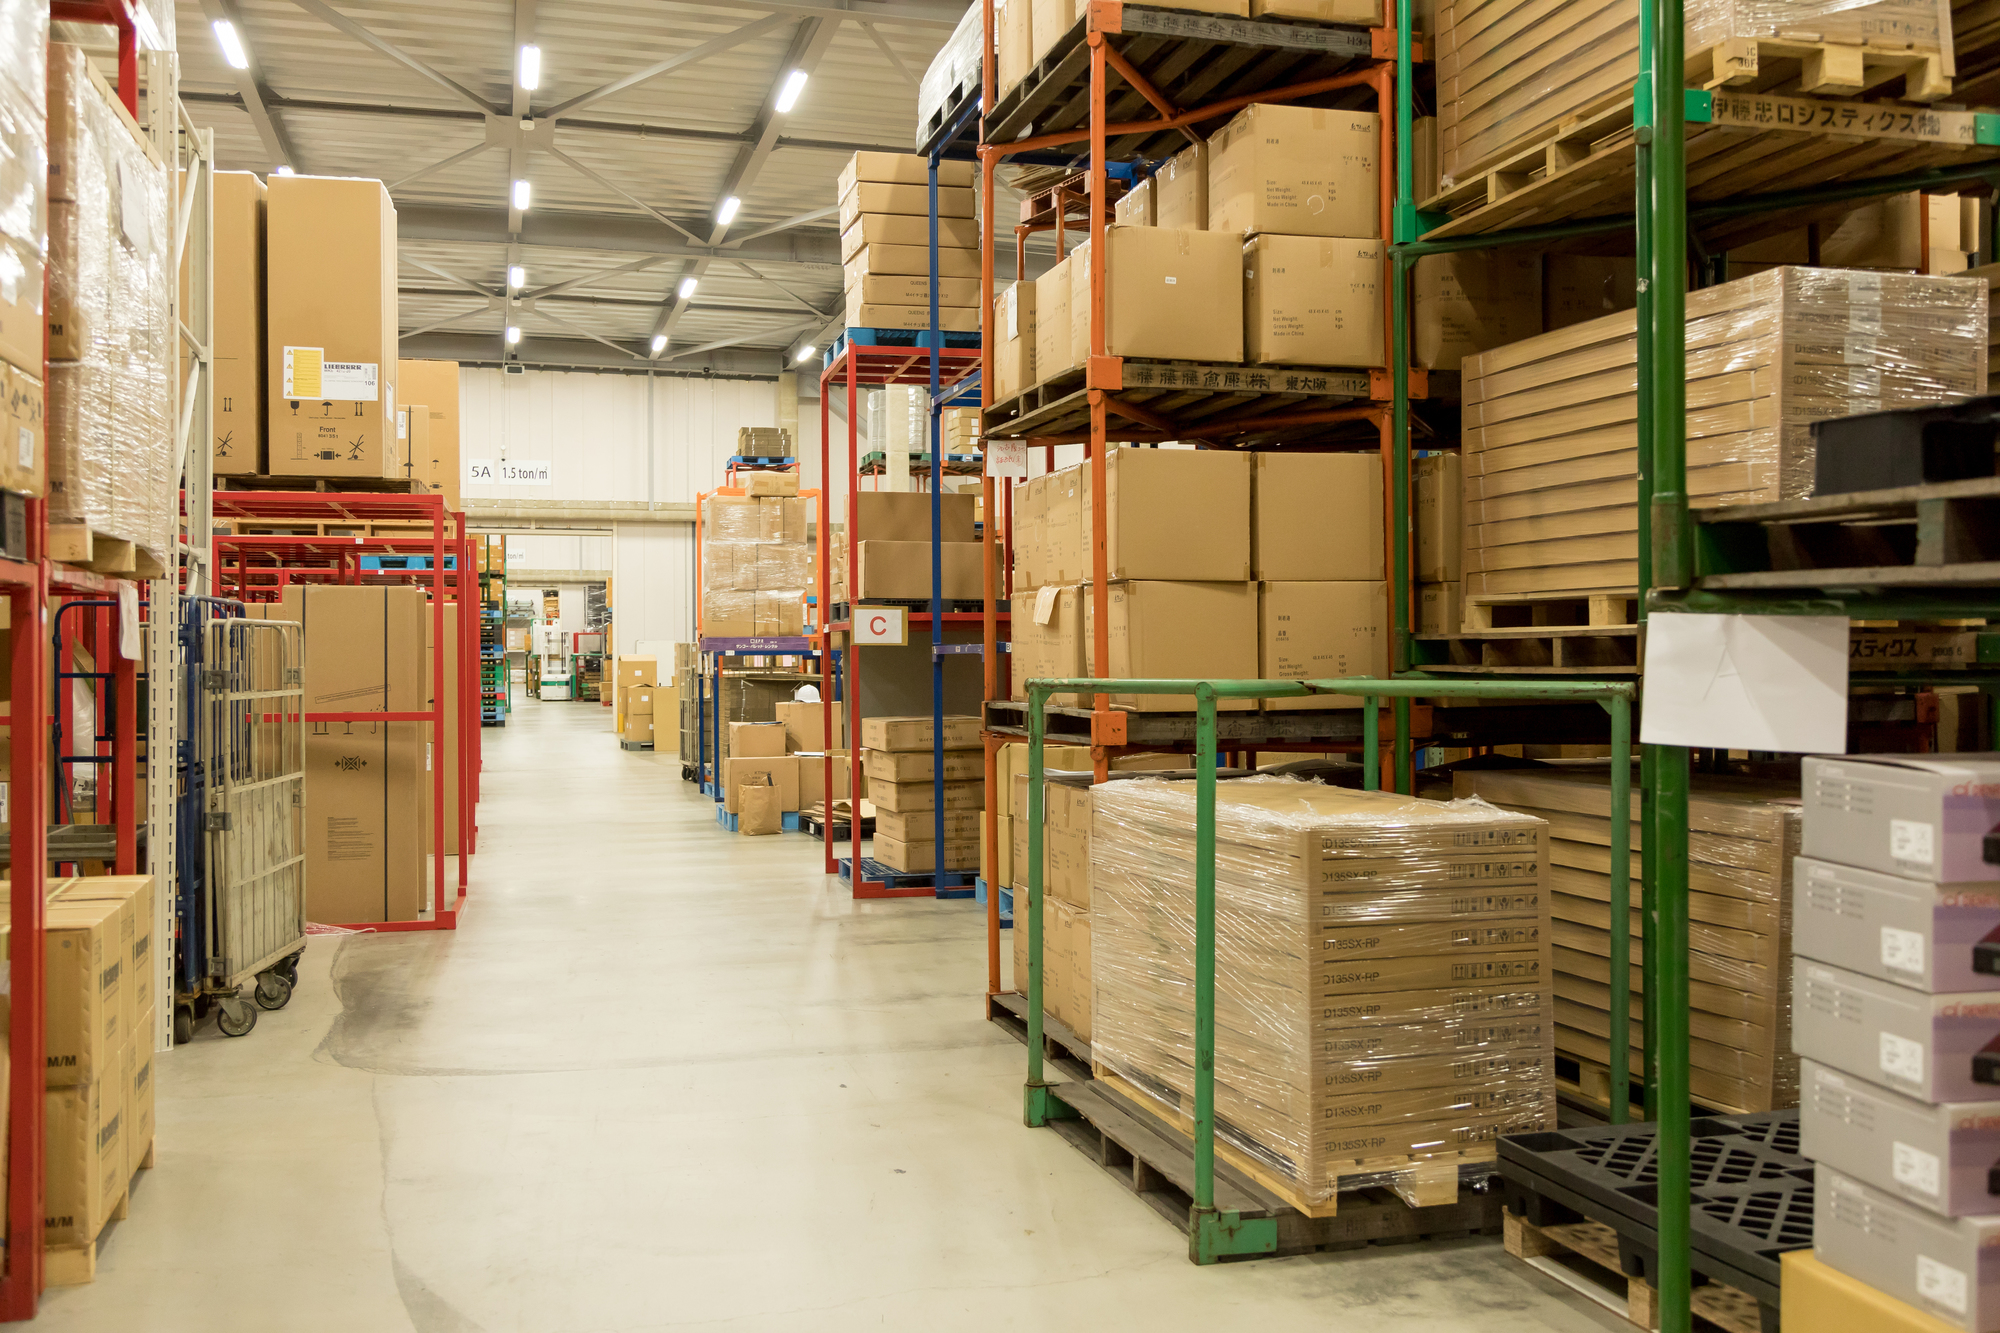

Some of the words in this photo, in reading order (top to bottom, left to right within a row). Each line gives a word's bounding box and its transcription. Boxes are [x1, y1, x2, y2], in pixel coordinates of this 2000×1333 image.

[471, 465, 492, 478] 5A
[502, 466, 517, 479] 1.5
[869, 615, 887, 636] C
[1323, 937, 1380, 950] D135SX-RP
[1323, 971, 1380, 985] D135SX-RP
[1324, 1004, 1381, 1019] D135SX-RP
[1325, 1071, 1383, 1086] D135SX-RP
[1325, 1104, 1383, 1119] D135SX-RP
